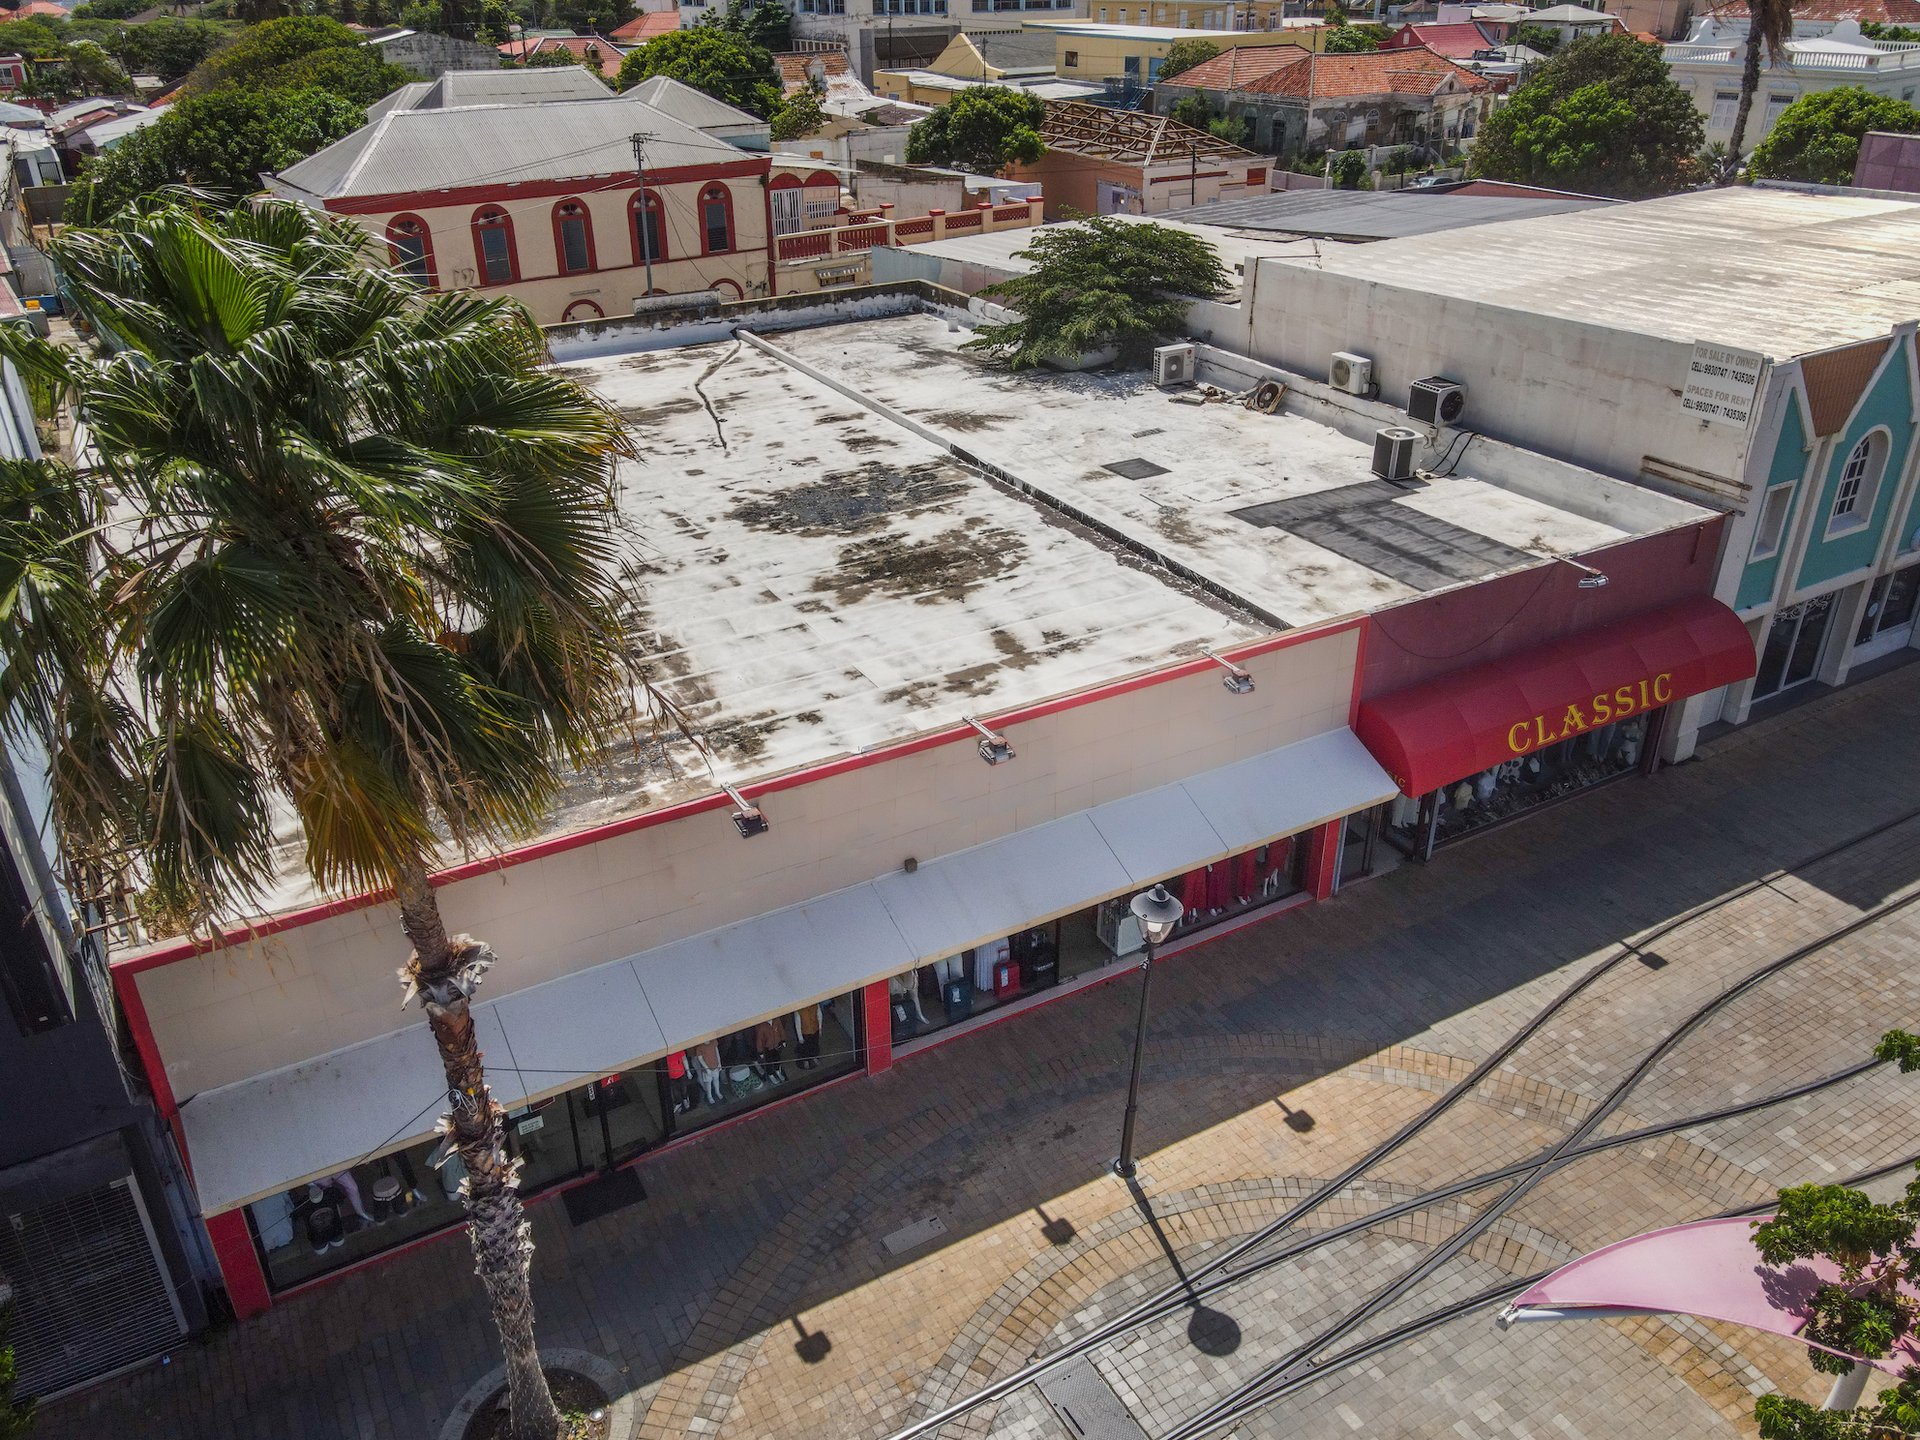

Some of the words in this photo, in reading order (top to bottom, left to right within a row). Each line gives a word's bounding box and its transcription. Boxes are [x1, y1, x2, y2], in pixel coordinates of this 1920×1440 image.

[1695, 347, 1708, 358] FOR
[1709, 350, 1725, 362] SALE
[1726, 353, 1735, 363] BY
[1736, 356, 1758, 370] OWNER
[1686, 384, 1713, 398] SPACES
[1715, 390, 1730, 401] FOR
[1731, 395, 1751, 407] RENT
[1508, 673, 1672, 753] CLASSIC
